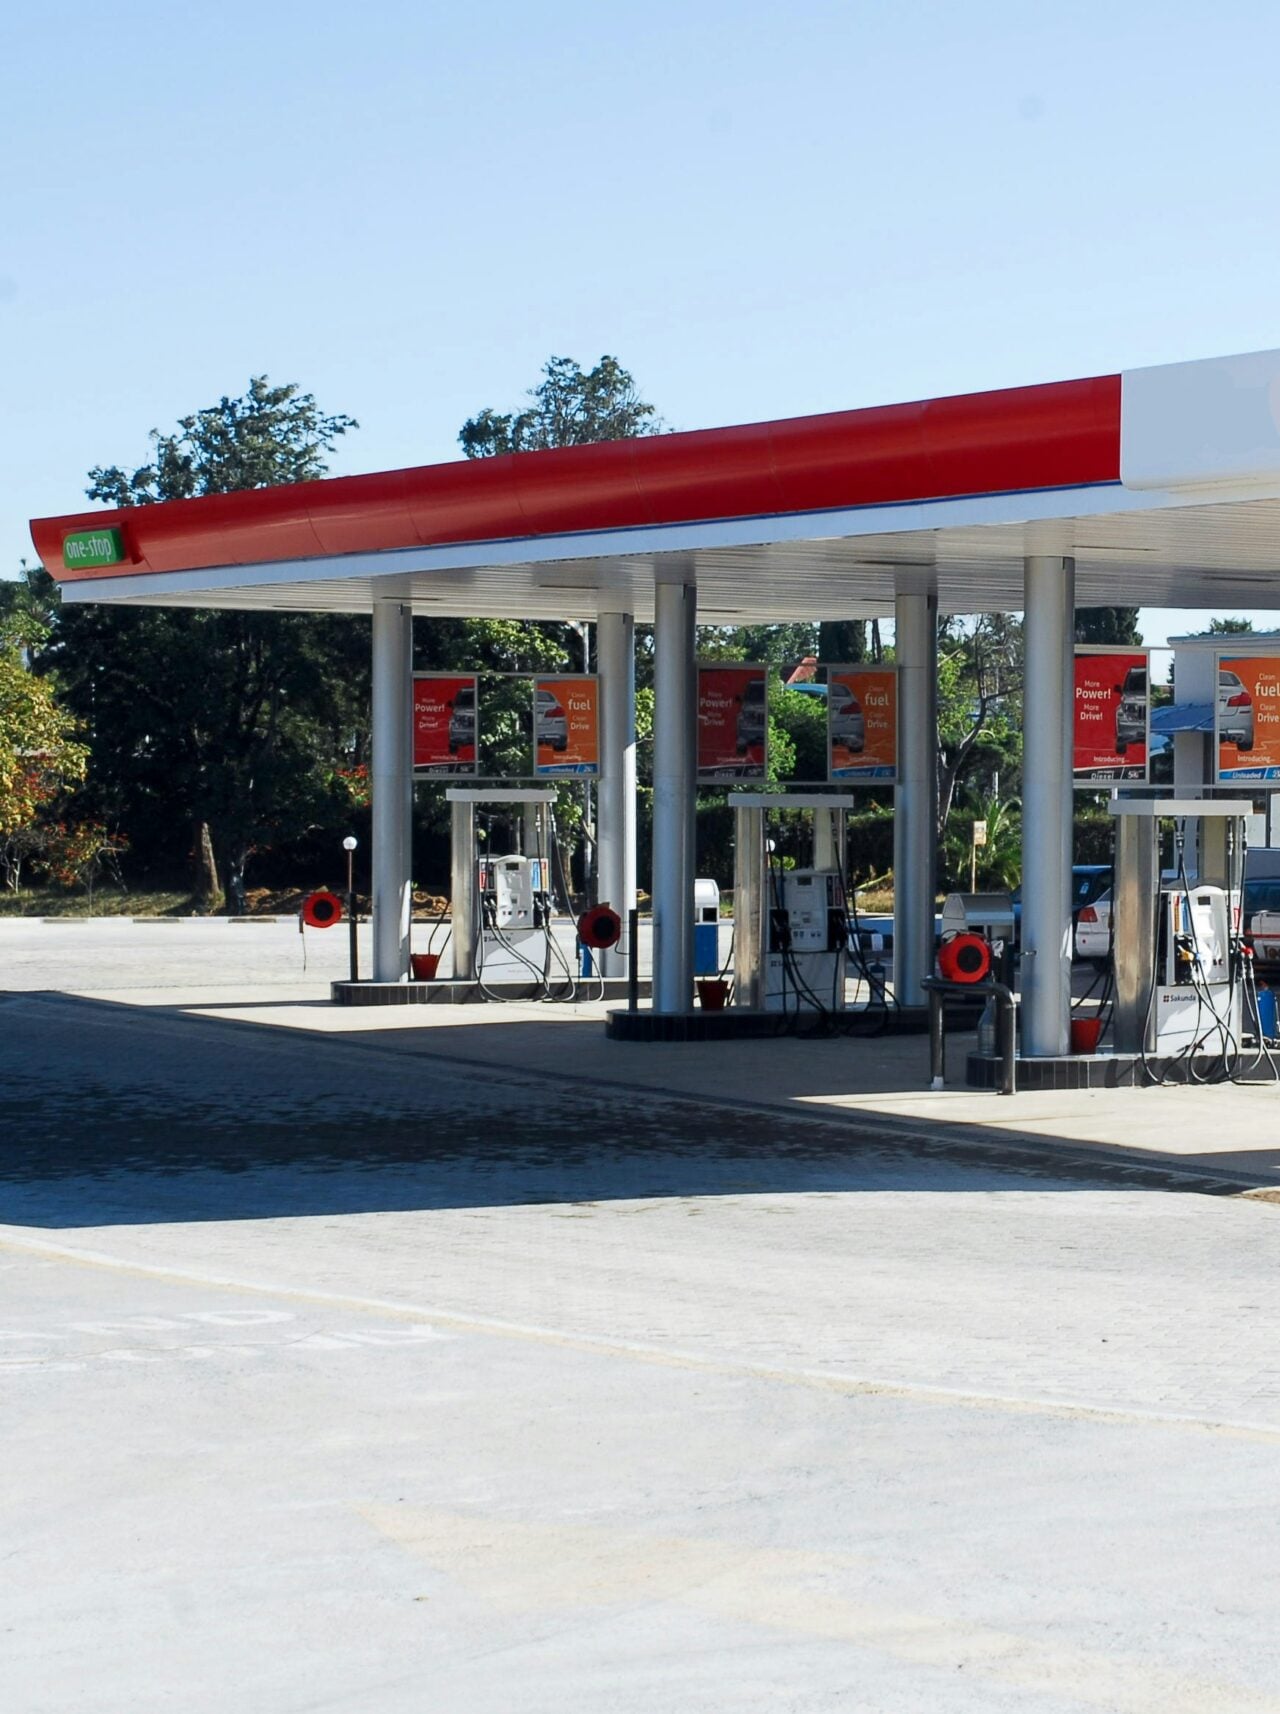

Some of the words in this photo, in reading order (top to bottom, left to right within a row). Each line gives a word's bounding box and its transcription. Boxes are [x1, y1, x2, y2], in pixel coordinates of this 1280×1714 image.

[66, 535, 112, 562] one-stop
[1259, 673, 1276, 681] Clean
[1084, 680, 1100, 688] More
[1075, 687, 1111, 700] Power!
[1255, 682, 1280, 697] fuel
[700, 699, 732, 709] Power!
[865, 693, 889, 706] fuel
[415, 703, 445, 713] Power!
[568, 699, 591, 711] fuel
[1259, 703, 1276, 711] Clean
[1080, 711, 1103, 720] Drive!
[1257, 713, 1280, 722] Drive
[419, 721, 438, 729] Drive!
[570, 722, 590, 730] Drive
[704, 719, 725, 727] Drive!
[867, 720, 888, 729] Drive
